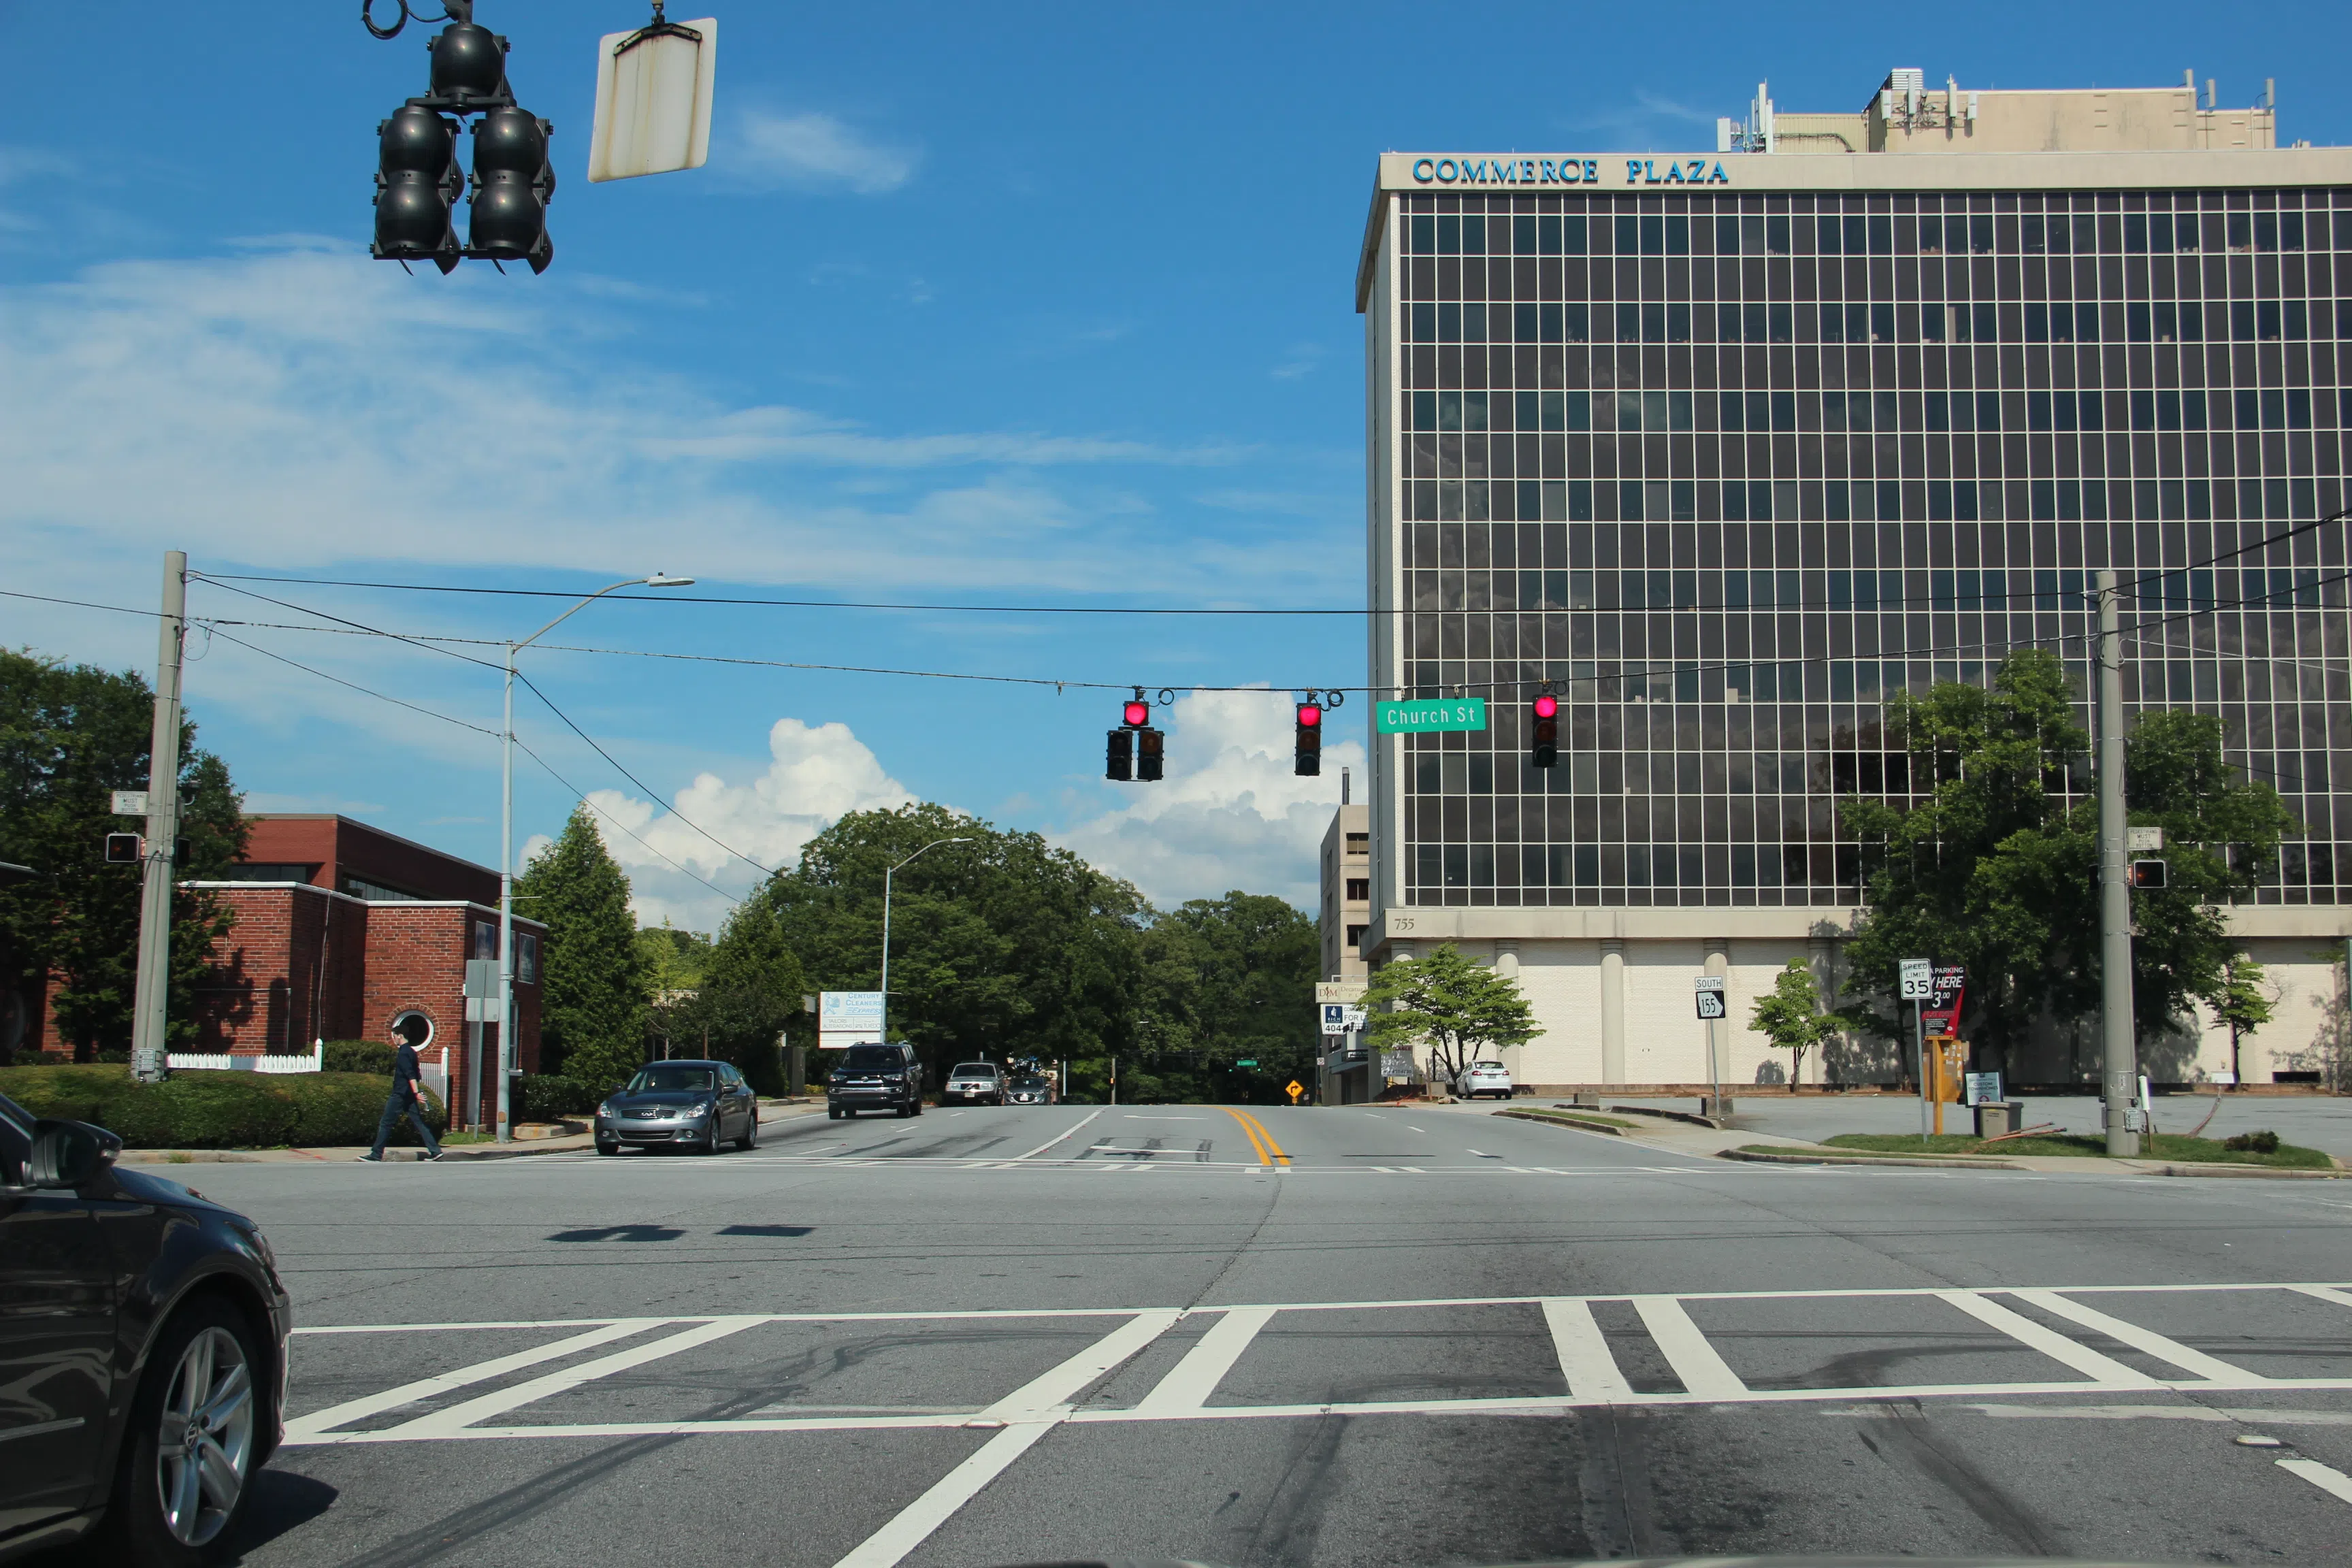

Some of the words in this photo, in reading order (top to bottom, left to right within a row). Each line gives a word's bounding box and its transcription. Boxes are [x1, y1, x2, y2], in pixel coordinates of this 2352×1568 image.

[1412, 159, 1599, 183] COMMERCE
[1627, 160, 1729, 184] PLAZA
[1387, 708, 1449, 725] Church
[1456, 706, 1475, 723] St
[1394, 918, 1414, 930] 755
[1697, 979, 1721, 987] SOUTH
[1904, 980, 1929, 994] 35
[1936, 976, 1963, 988] HERE
[1701, 998, 1716, 1013] 155
